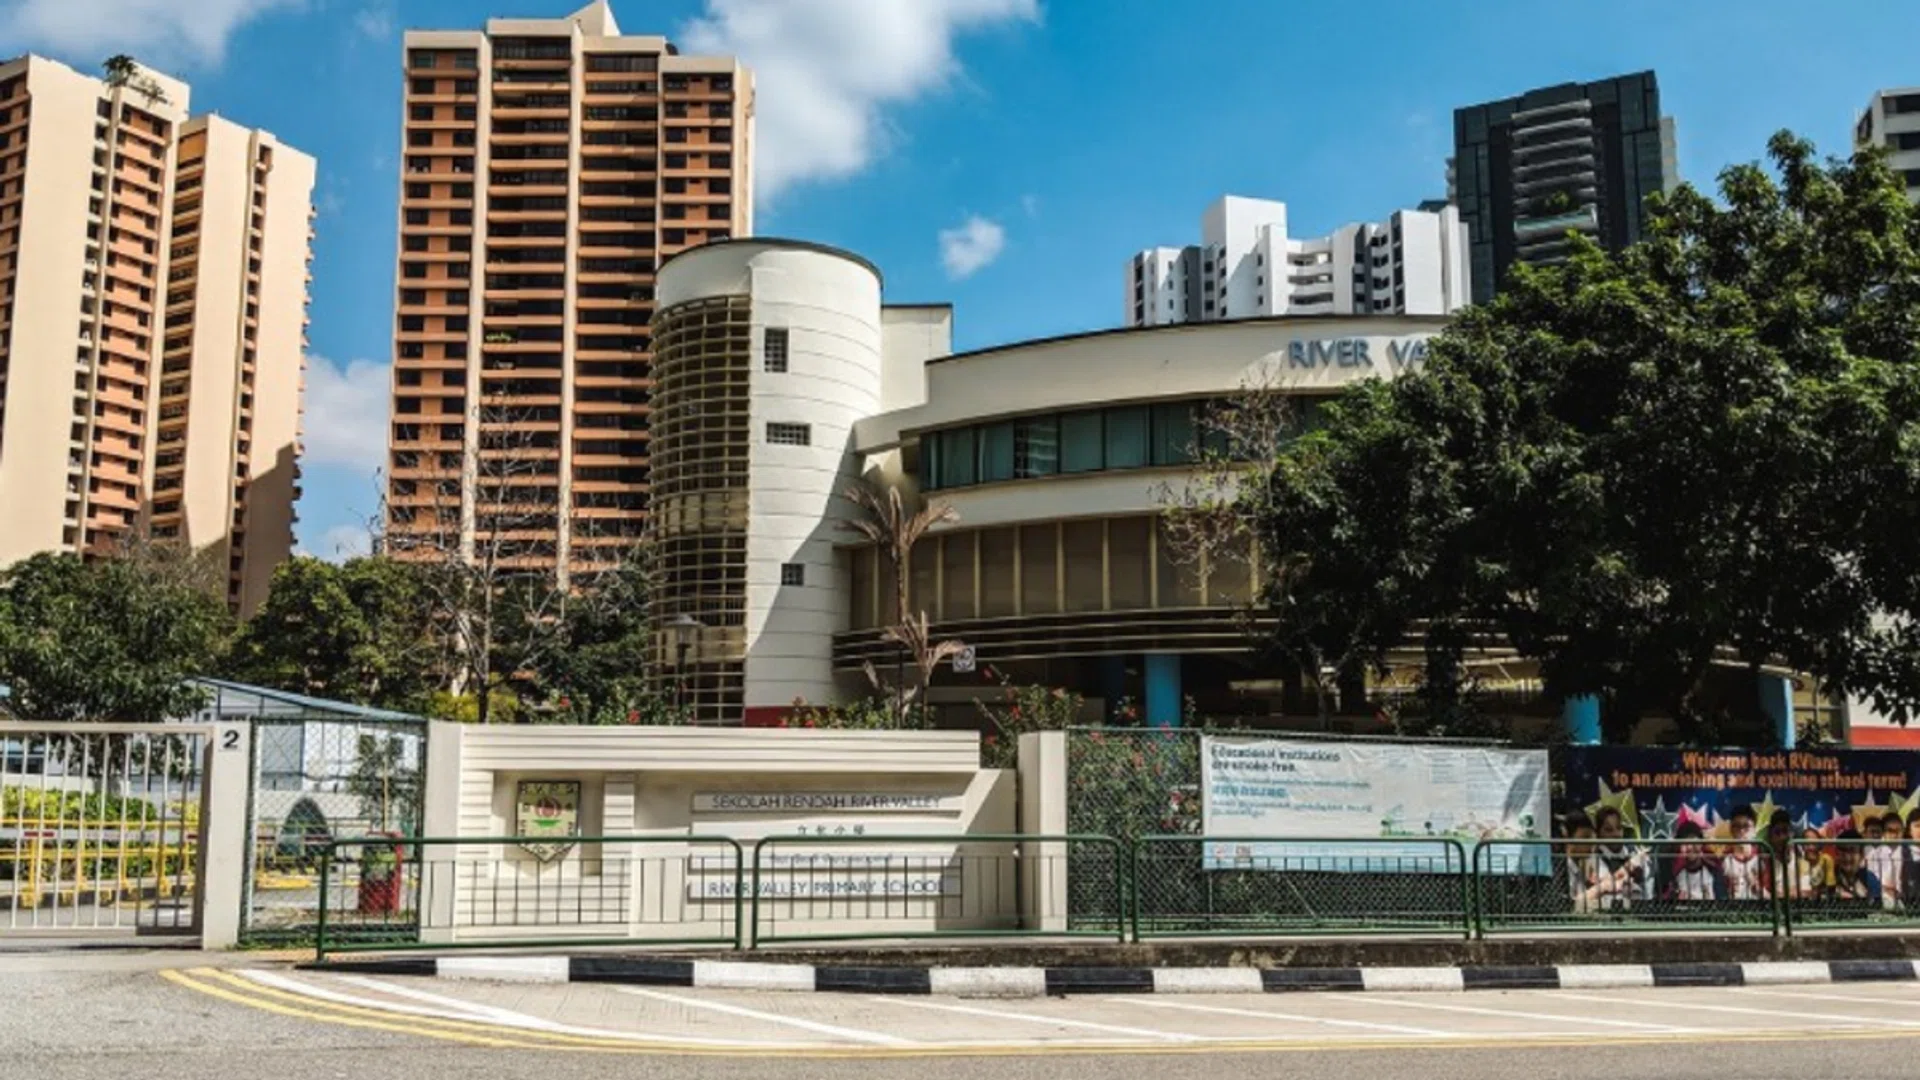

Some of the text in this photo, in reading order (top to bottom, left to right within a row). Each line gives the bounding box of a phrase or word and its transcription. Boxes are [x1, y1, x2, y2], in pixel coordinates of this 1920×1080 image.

[1288, 338, 1374, 368] RIVER
[223, 729, 240, 749] 2
[1682, 752, 1748, 770] Welcome
[1750, 752, 1786, 769] back
[1612, 770, 1629, 787] to
[1632, 772, 1650, 787] an
[1727, 771, 1755, 788] and
[1820, 771, 1865, 789] school
[712, 795, 940, 808] SEKOLAH RENDAH RIVER VALLEY
[709, 881, 751, 896] RIVR
[814, 880, 876, 894] PRIMARY
